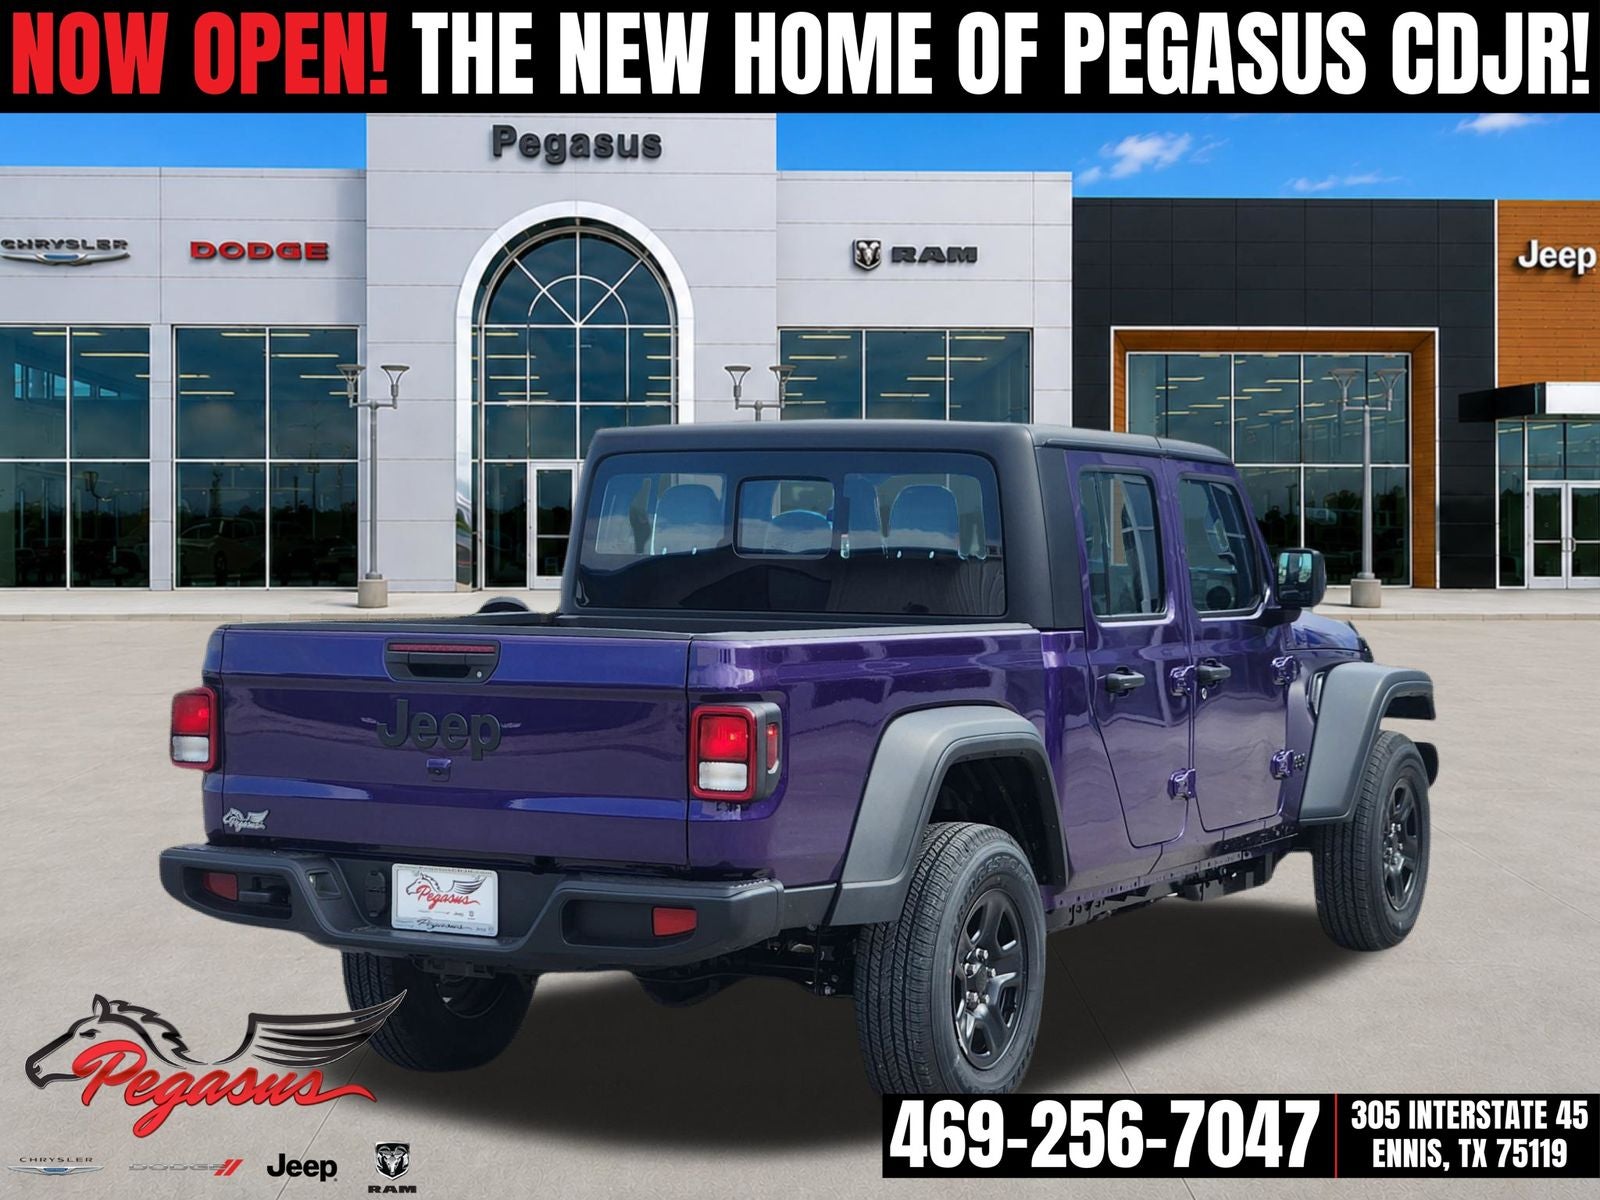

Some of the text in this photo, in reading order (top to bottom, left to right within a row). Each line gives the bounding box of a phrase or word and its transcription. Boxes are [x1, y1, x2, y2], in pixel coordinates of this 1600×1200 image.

[491, 124, 663, 166] Pegasus
[0, 239, 128, 250] CHRYSLER
[190, 241, 329, 261] DODGE
[890, 246, 978, 264] RAM
[1517, 240, 1596, 275] Jeep
[376, 699, 502, 761] Jeep
[416, 884, 480, 910] Pegasus
